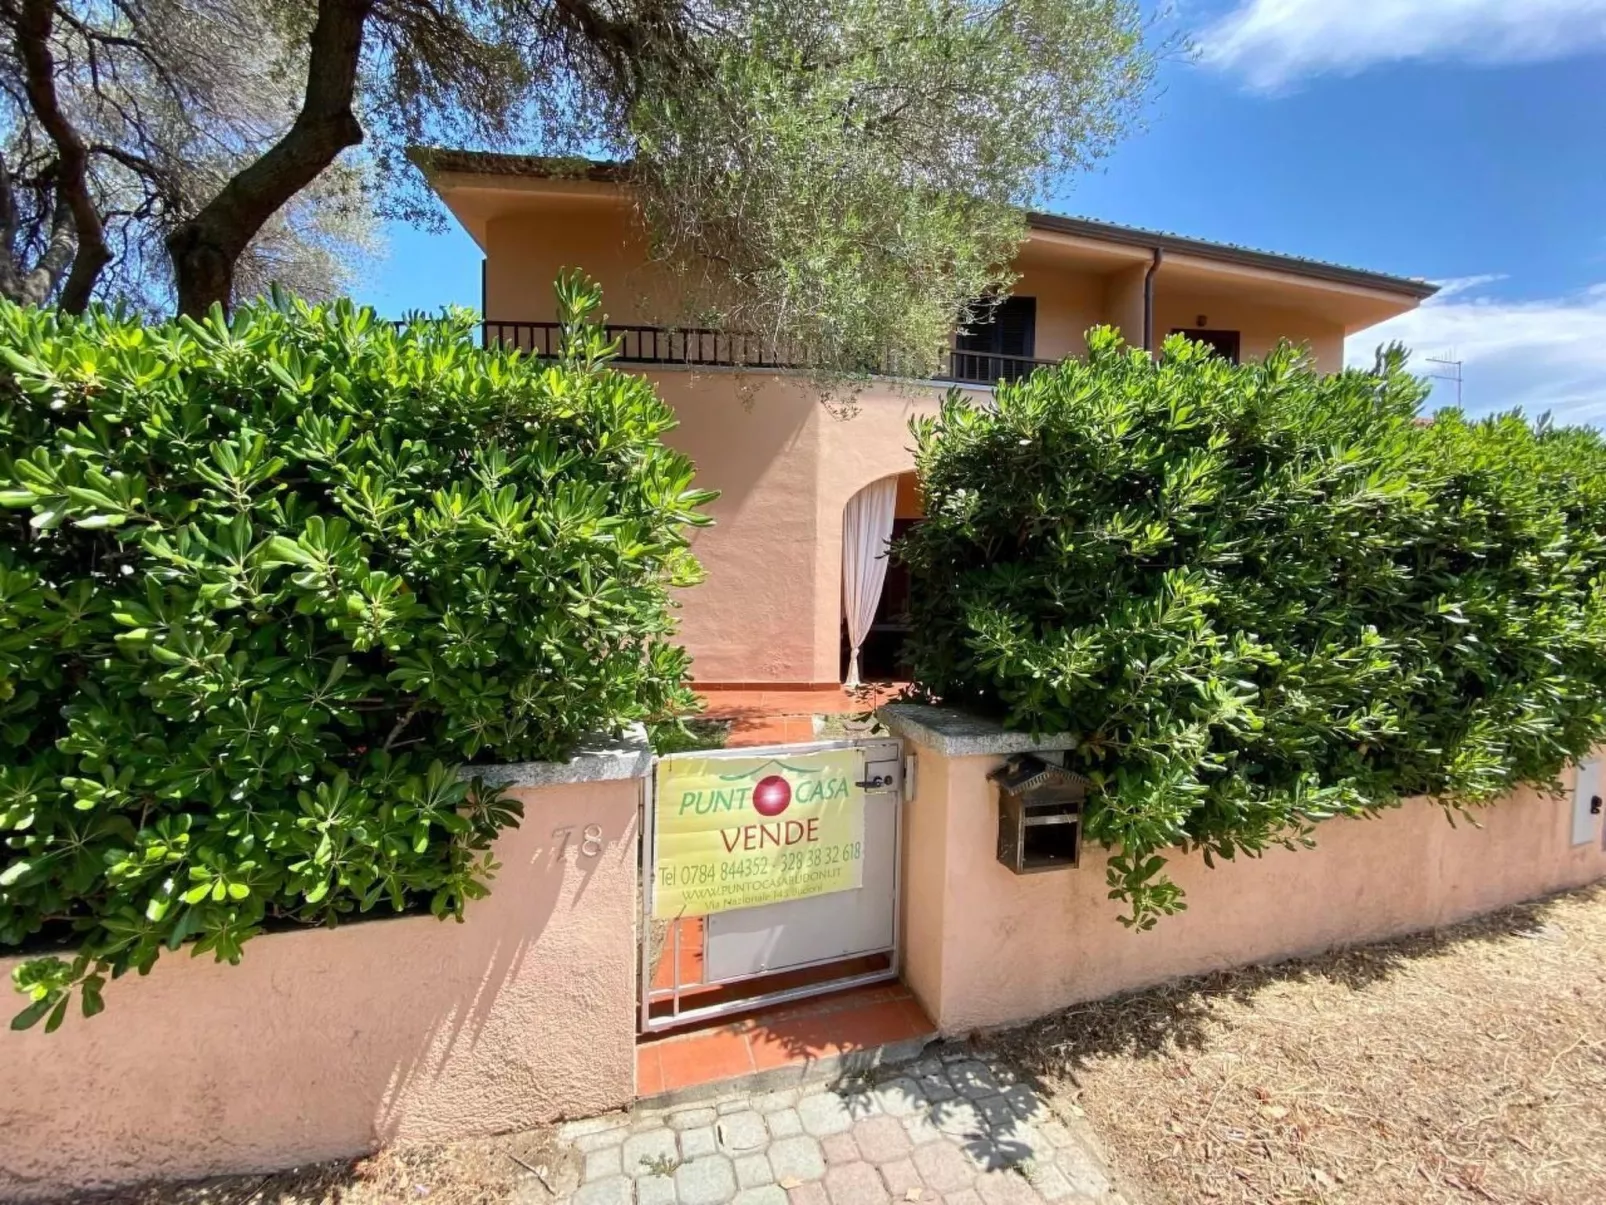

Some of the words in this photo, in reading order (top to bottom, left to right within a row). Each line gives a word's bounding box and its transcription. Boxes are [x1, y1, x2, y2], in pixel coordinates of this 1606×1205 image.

[795, 778, 849, 804] CASA
[720, 817, 820, 853] VENDE
[659, 865, 676, 887] Tel
[680, 863, 716, 885] 0784
[720, 856, 768, 881] 844352
[780, 851, 804, 873] 328
[806, 848, 822, 867] 38
[825, 845, 841, 865] 32
[842, 841, 861, 862] 618
